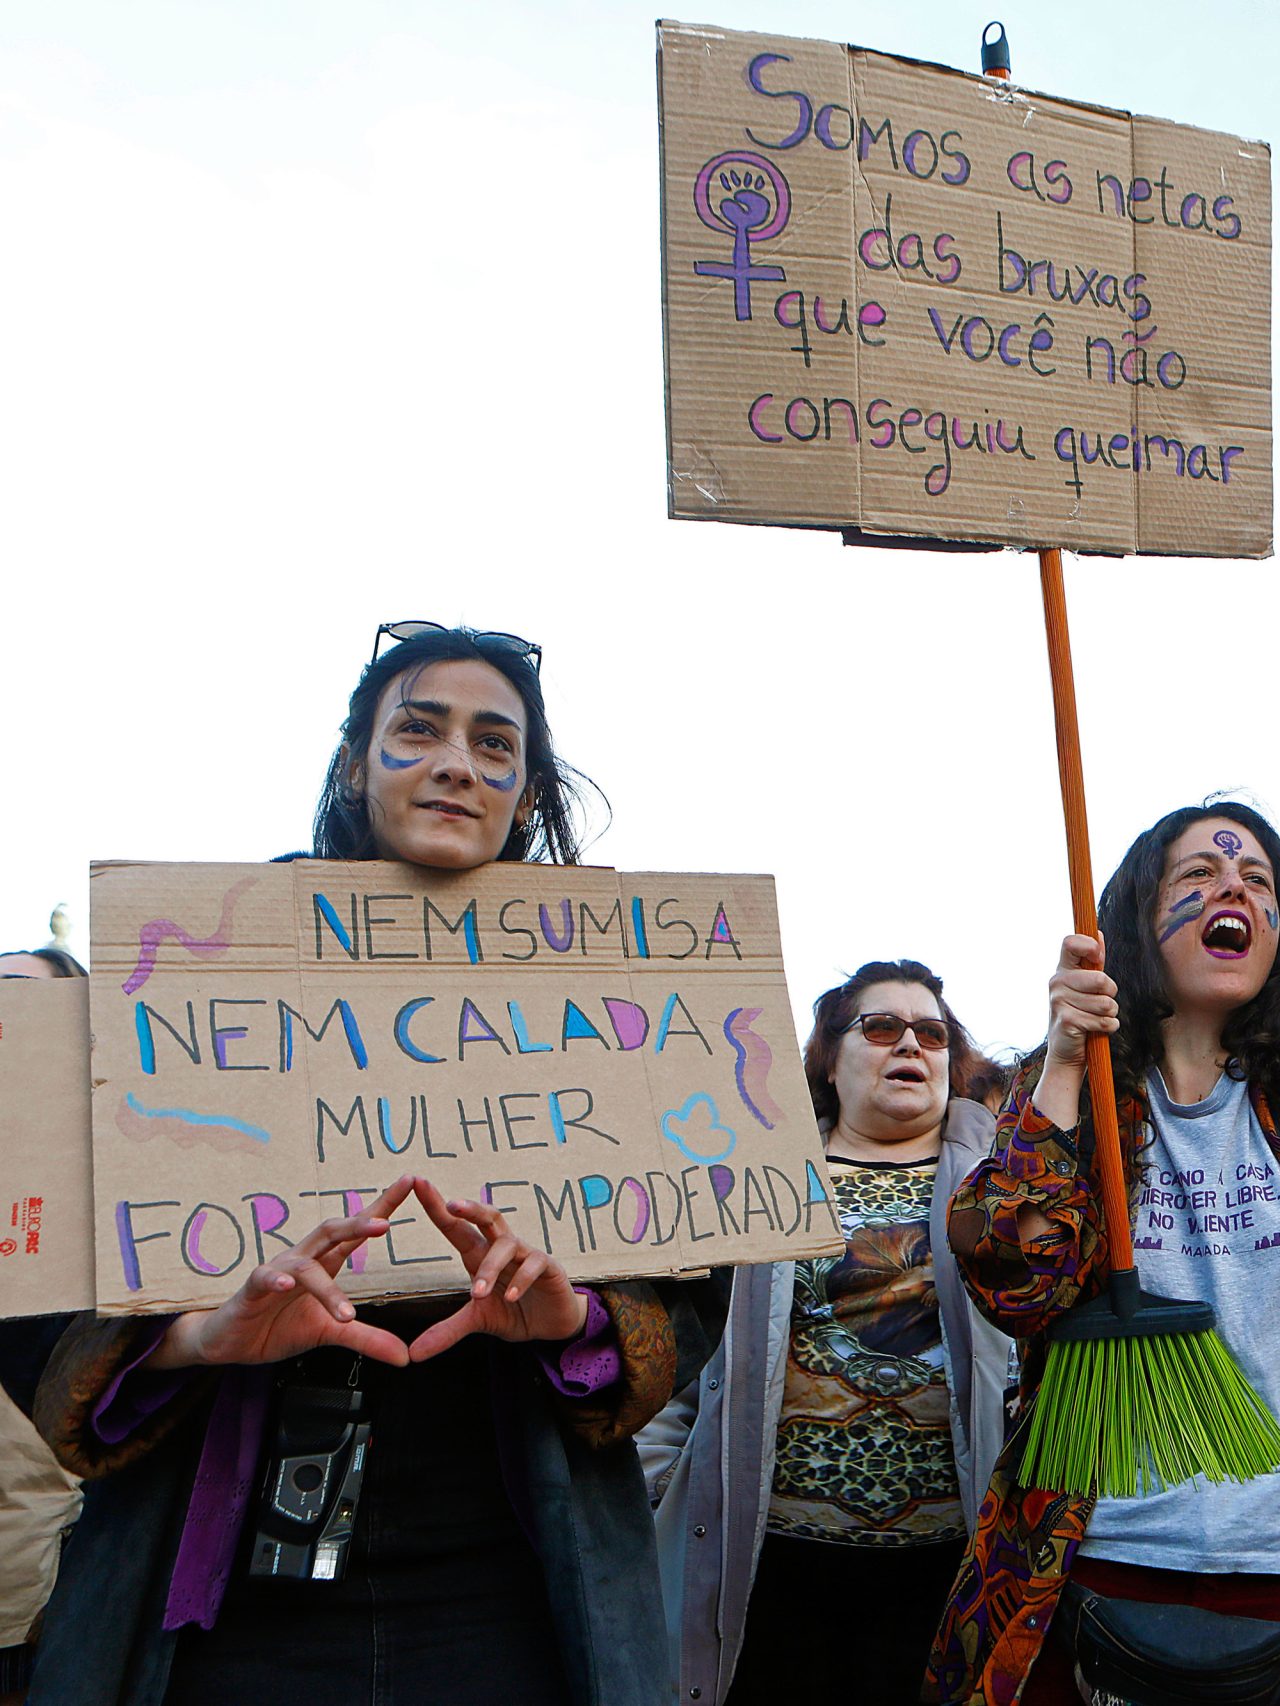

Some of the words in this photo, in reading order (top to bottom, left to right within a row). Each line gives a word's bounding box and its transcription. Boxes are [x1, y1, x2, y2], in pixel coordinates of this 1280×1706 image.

[745, 53, 971, 185] Somos
[1007, 152, 1073, 203] as
[1098, 166, 1243, 239] netas
[858, 193, 961, 284] das
[998, 211, 1151, 320] bruxas
[774, 290, 886, 368] que
[928, 308, 1055, 375] você
[1086, 326, 1186, 390] não
[749, 393, 1035, 496] conseguiu
[1054, 427, 1244, 499] queimar
[314, 894, 480, 965] NEM
[502, 897, 743, 961] SUMISA
[136, 1000, 369, 1074] NEM
[394, 993, 713, 1063] CALADA
[317, 1089, 620, 1163] MULHER
[1235, 1162, 1275, 1182] CASA
[1149, 1211, 1174, 1230] NO
